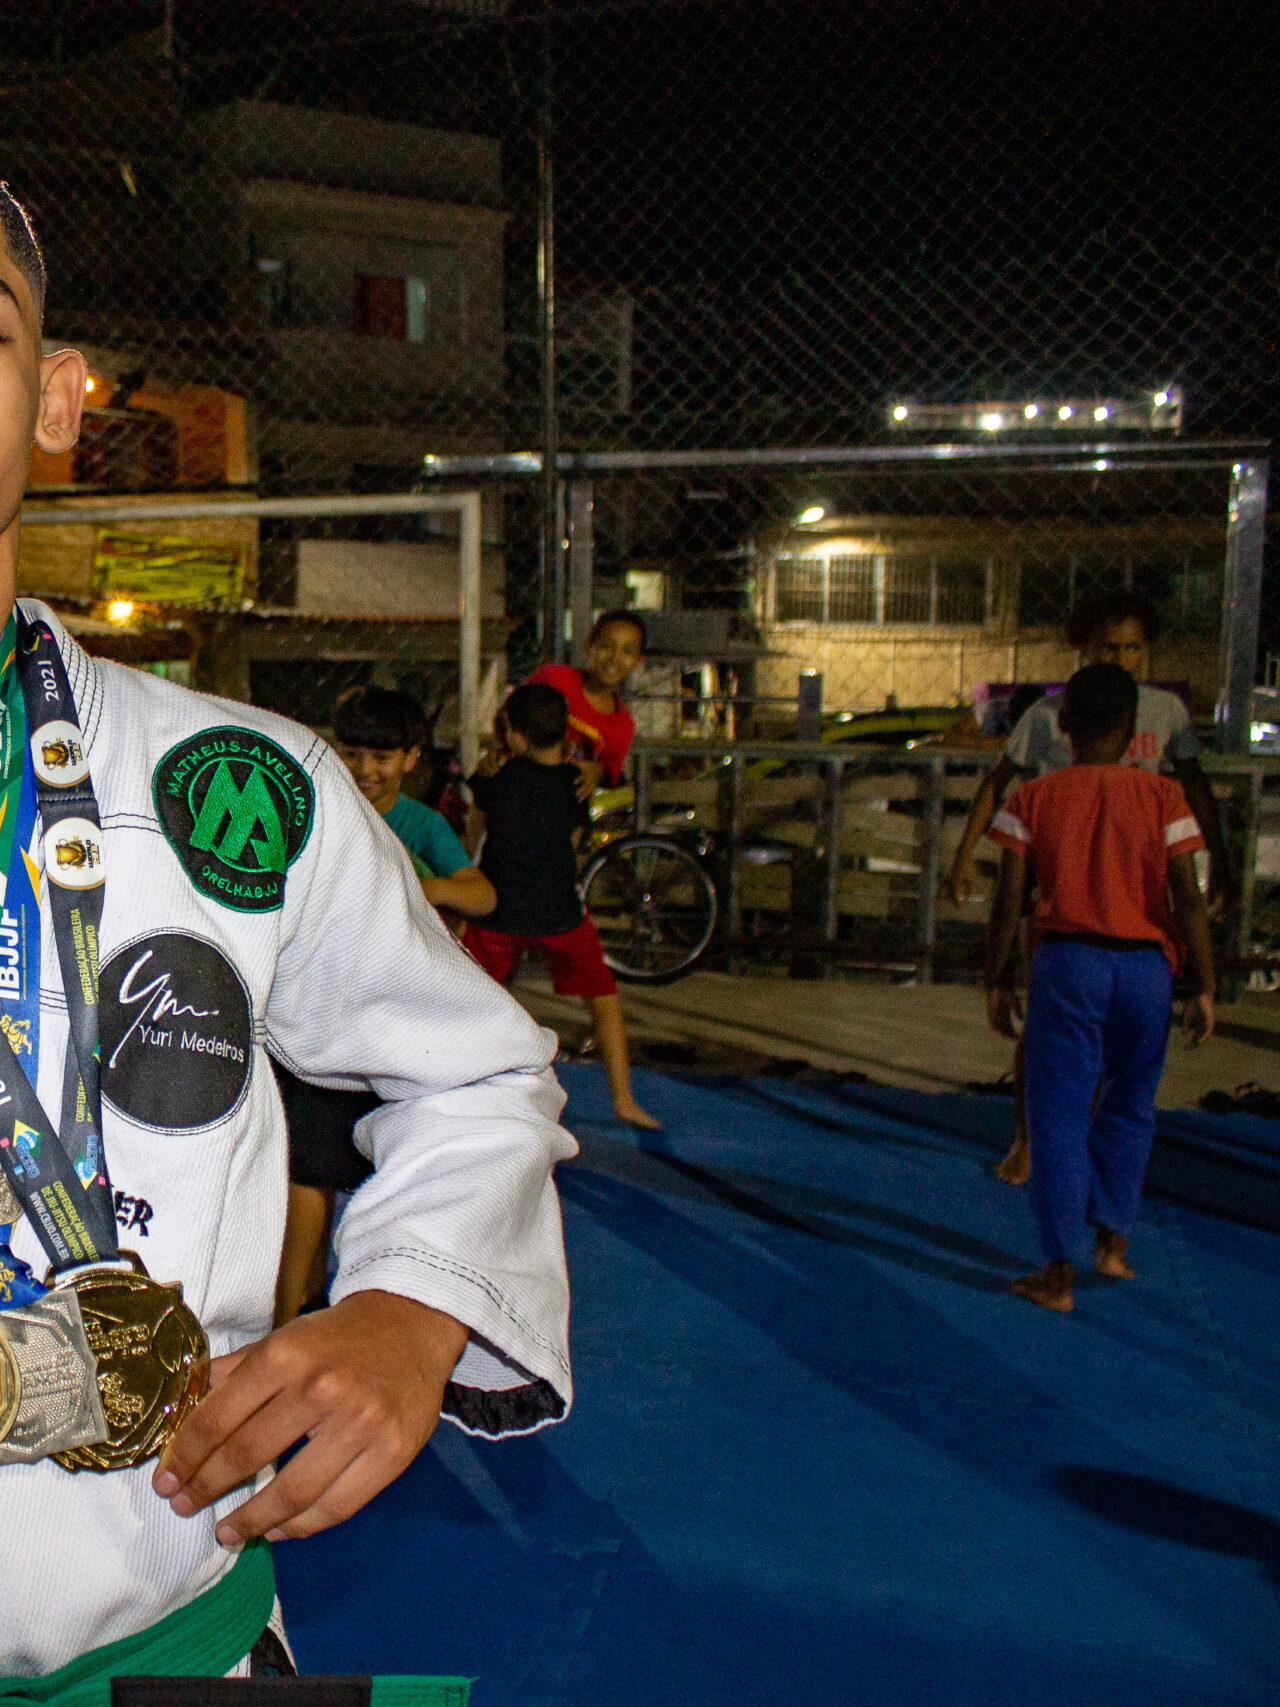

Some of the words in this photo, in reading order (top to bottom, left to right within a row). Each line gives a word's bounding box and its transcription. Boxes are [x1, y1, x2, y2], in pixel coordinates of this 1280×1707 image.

[37, 660, 59, 702] 2021
[70, 907, 85, 950] BRASILEIRA
[75, 949, 95, 1005] CONFEDERAÇÃO
[139, 1024, 173, 1048] Yuri
[180, 1031, 244, 1063] Medeiros
[41, 1186, 53, 1198] DE
[45, 1196, 68, 1228] JIU-JITSU
[53, 1181, 85, 1233] CONFEDERAÇÃO
[30, 1191, 70, 1261] WWW.CBJJO.COM.BR
